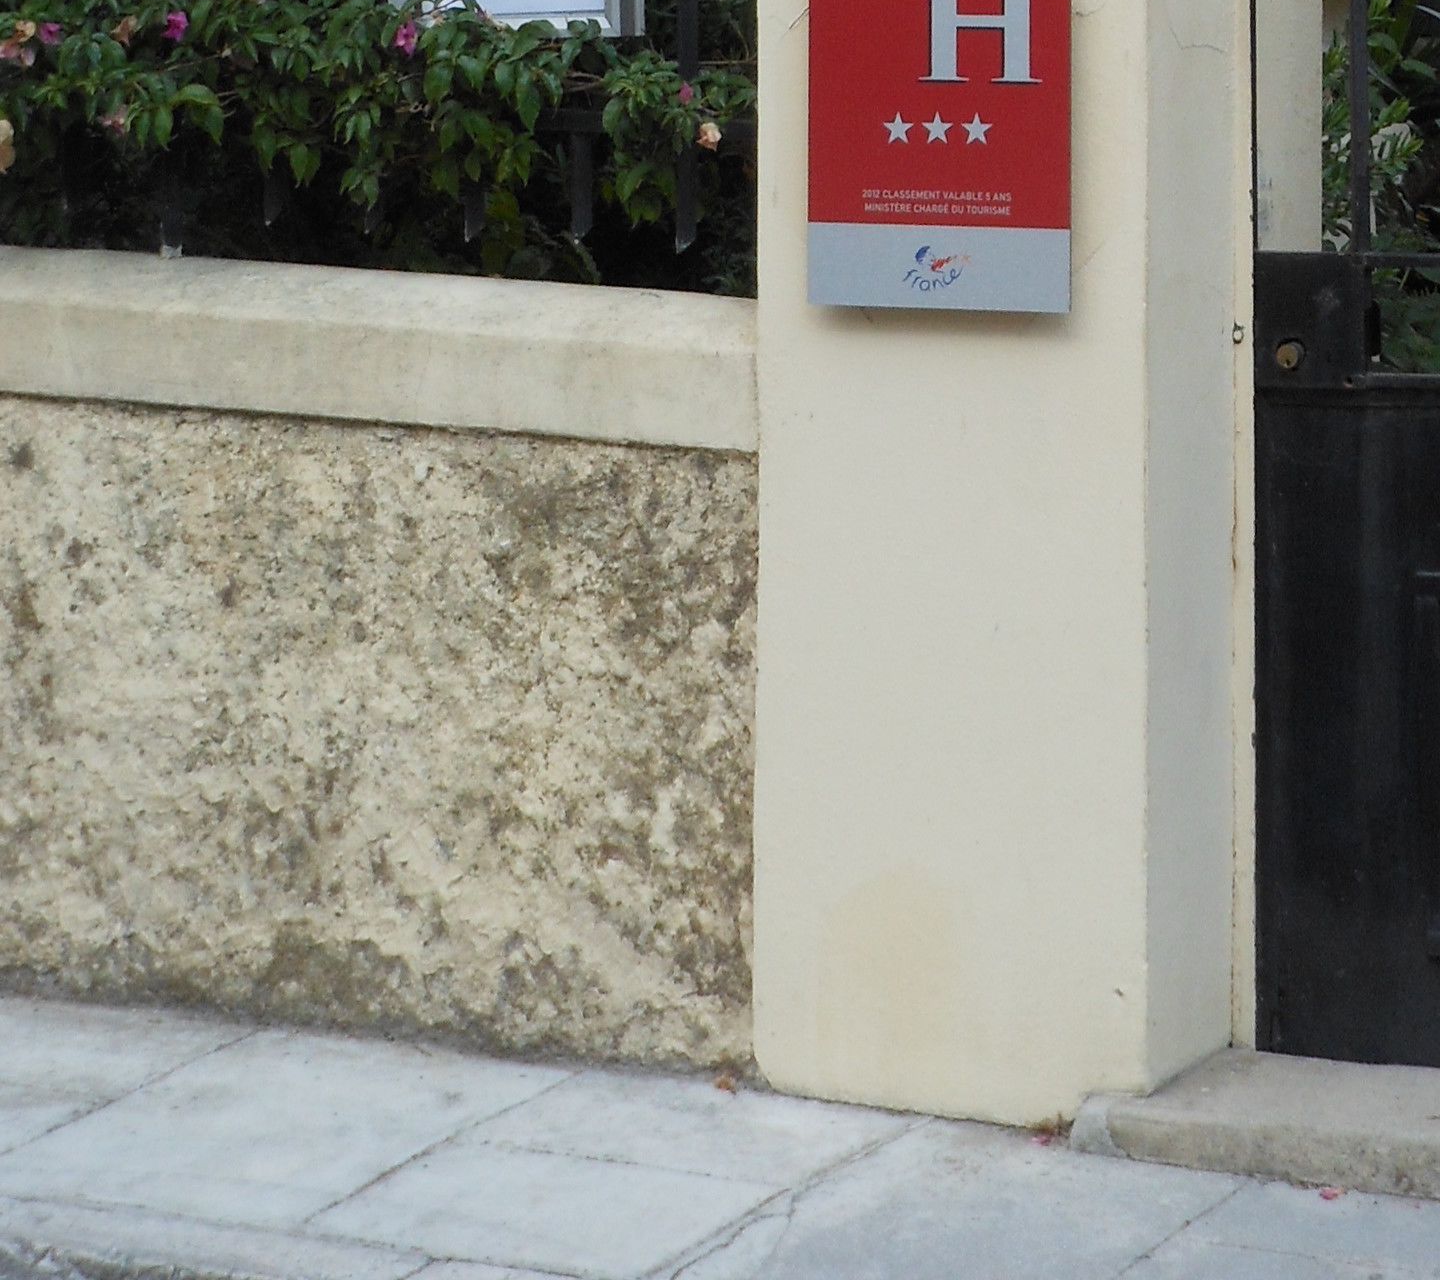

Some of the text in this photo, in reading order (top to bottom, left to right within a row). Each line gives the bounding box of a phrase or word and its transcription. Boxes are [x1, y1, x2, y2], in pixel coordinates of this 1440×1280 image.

[882, 190, 940, 200] CLASSEMENT
[942, 191, 983, 201] VALABLE
[992, 192, 1012, 202] ANS
[951, 204, 964, 215] DU
[965, 205, 1011, 216] TOURISME
